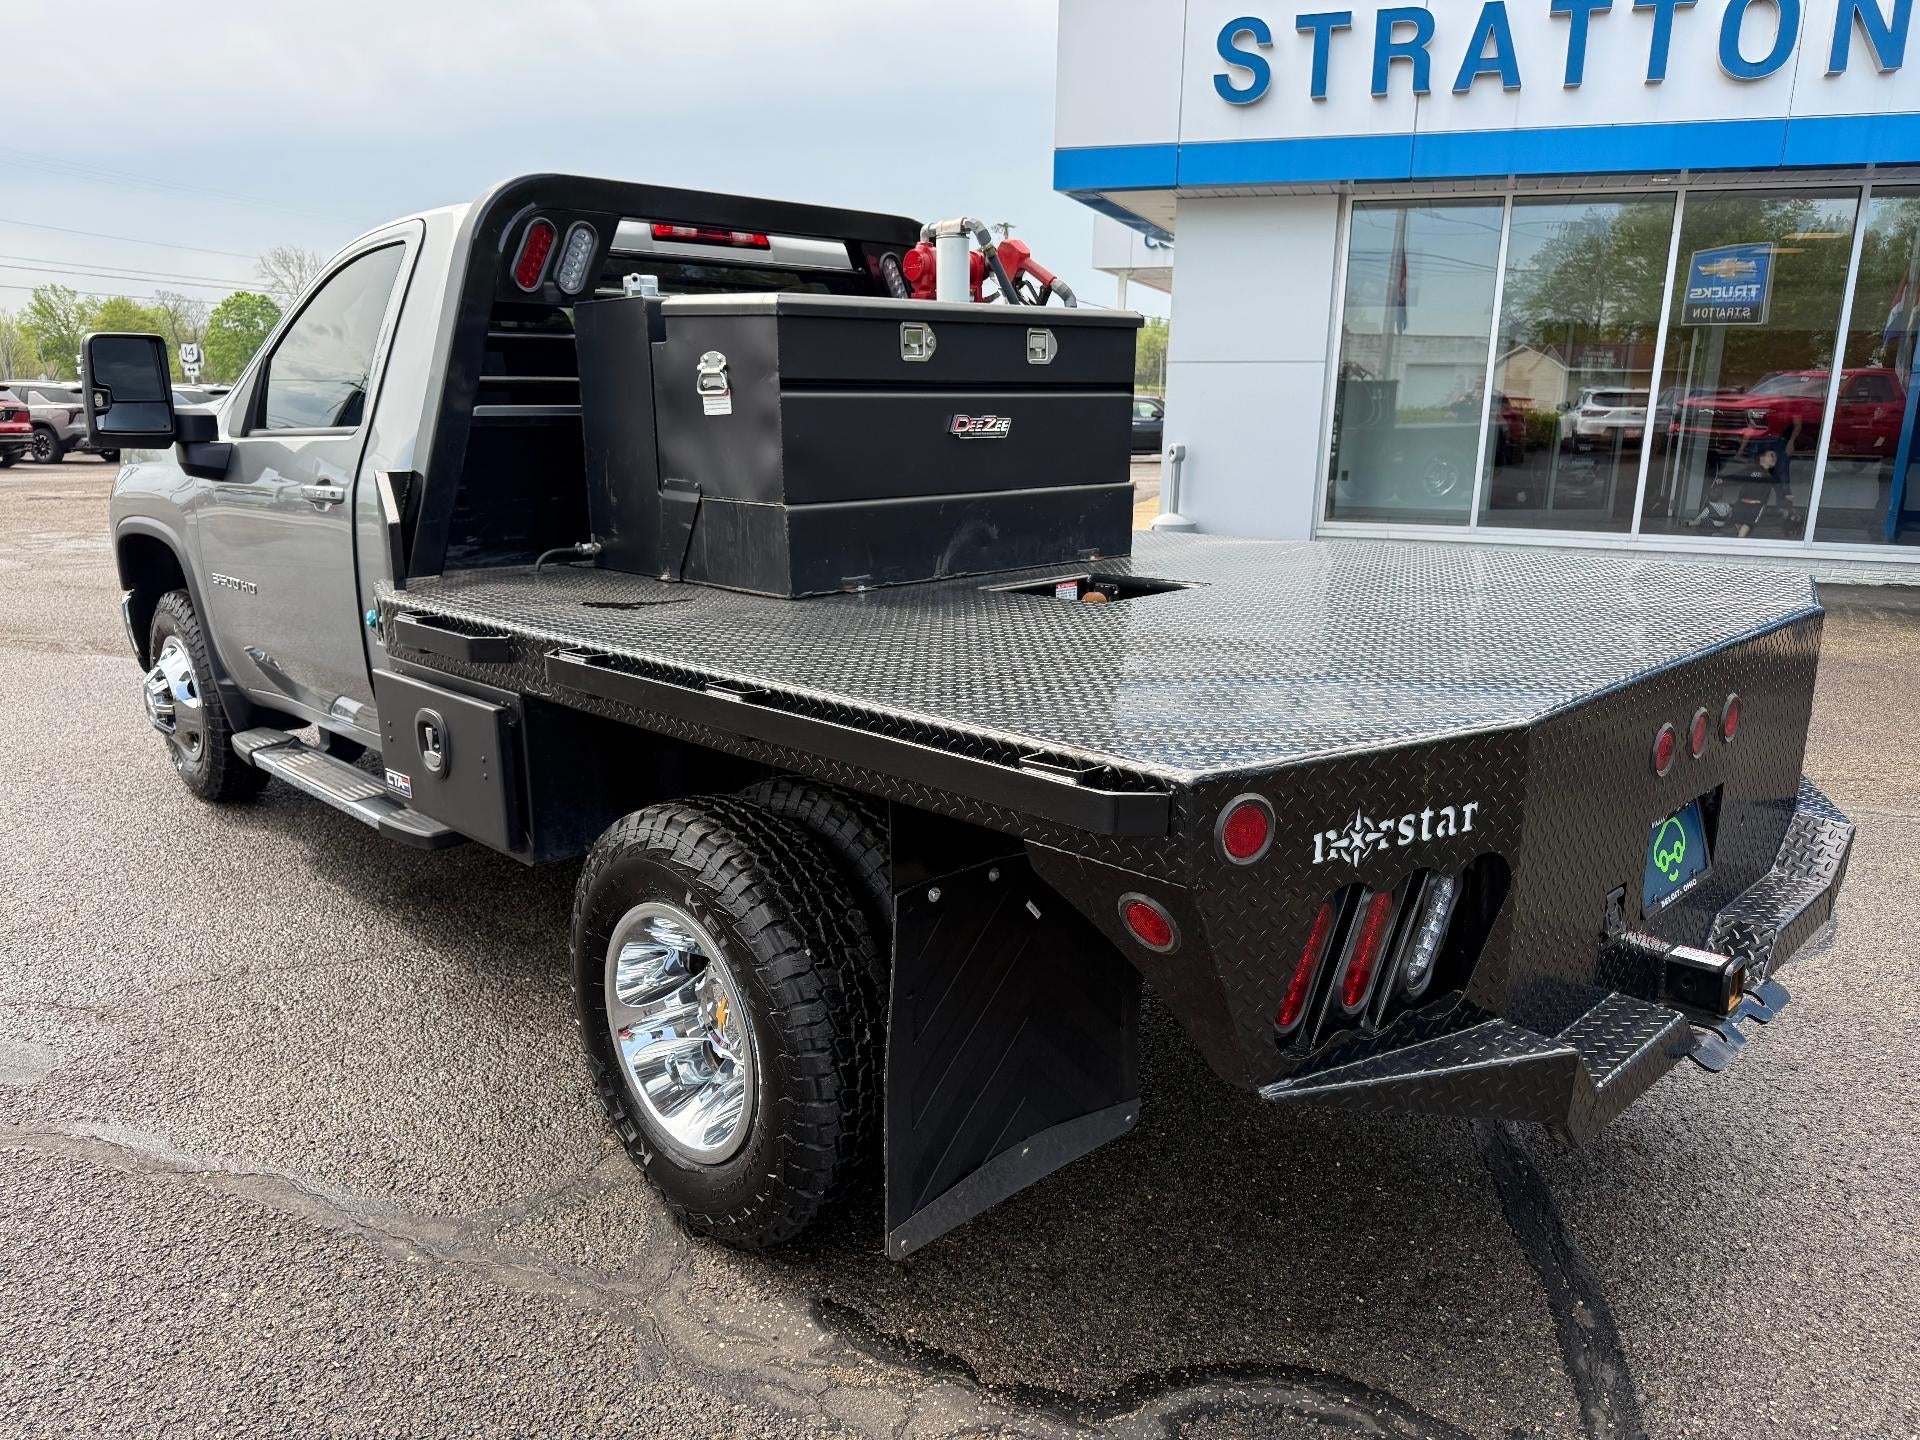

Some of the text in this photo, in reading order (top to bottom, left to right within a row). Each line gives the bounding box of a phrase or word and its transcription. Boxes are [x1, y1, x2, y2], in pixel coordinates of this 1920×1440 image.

[1213, 0, 1914, 104] STRATTON
[183, 346, 195, 358] 14
[1683, 878, 1697, 892] OHIO
